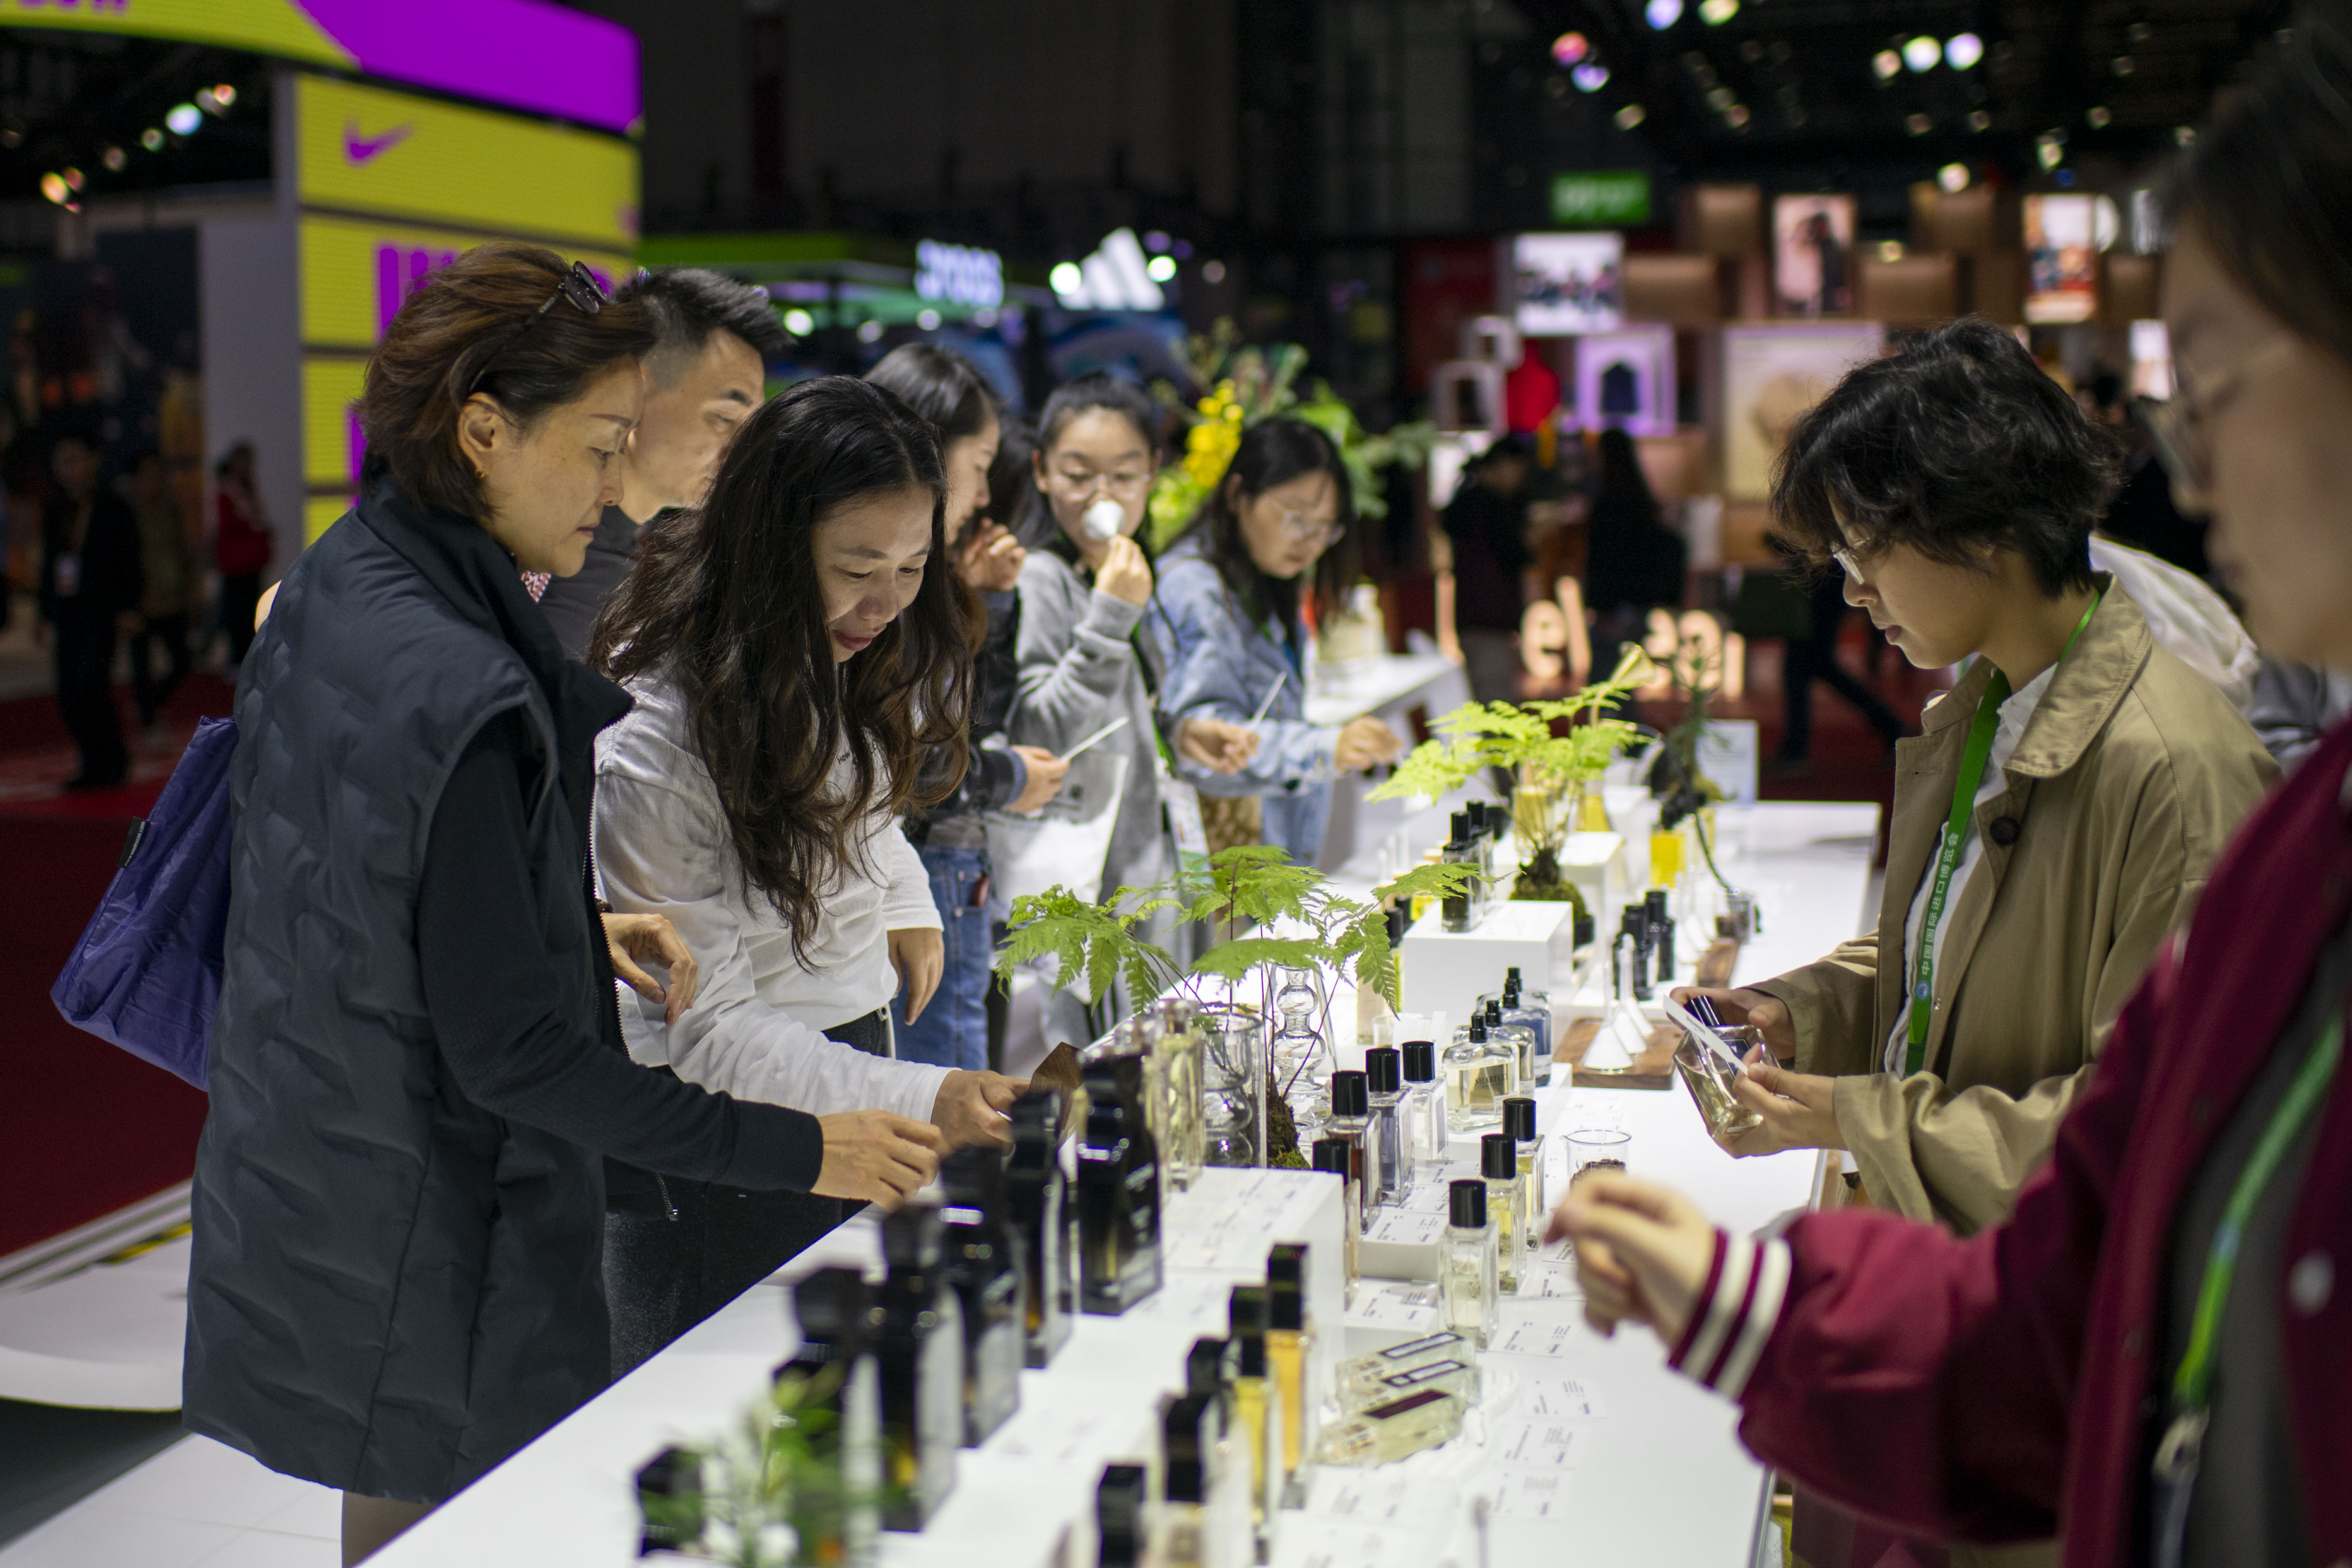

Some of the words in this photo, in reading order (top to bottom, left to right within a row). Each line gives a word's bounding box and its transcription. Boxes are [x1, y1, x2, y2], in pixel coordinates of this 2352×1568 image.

[1921, 832, 1959, 975] 中国国际进口博览会
